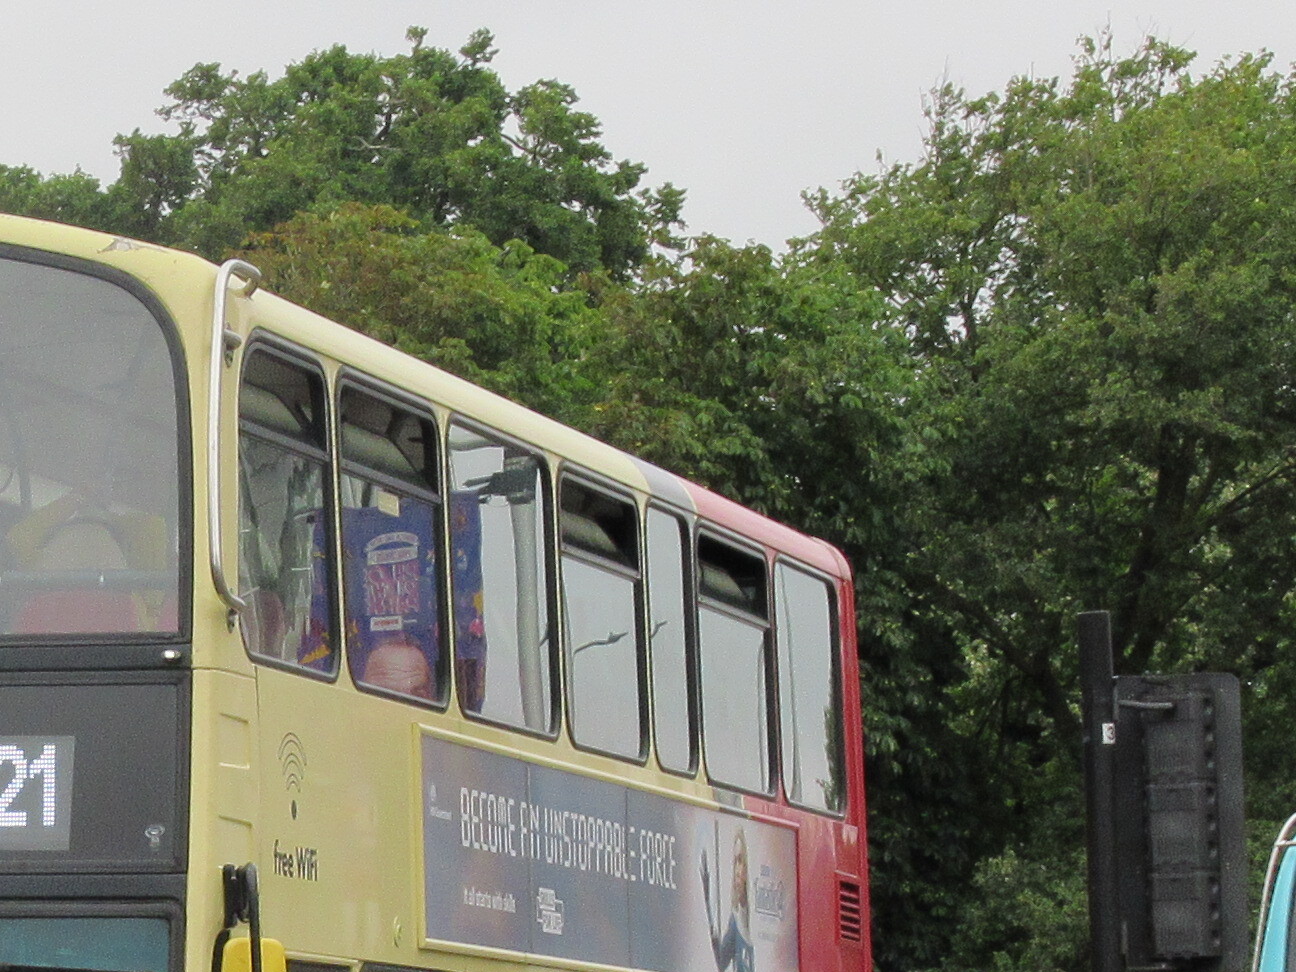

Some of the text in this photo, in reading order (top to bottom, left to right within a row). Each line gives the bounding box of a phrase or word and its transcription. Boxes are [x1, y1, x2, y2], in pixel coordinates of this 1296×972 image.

[273, 839, 294, 878] free
[460, 786, 516, 857] BECOME
[520, 801, 540, 861] AN
[544, 807, 636, 881] UNSTOPPABLE
[640, 828, 677, 890] FORCE
